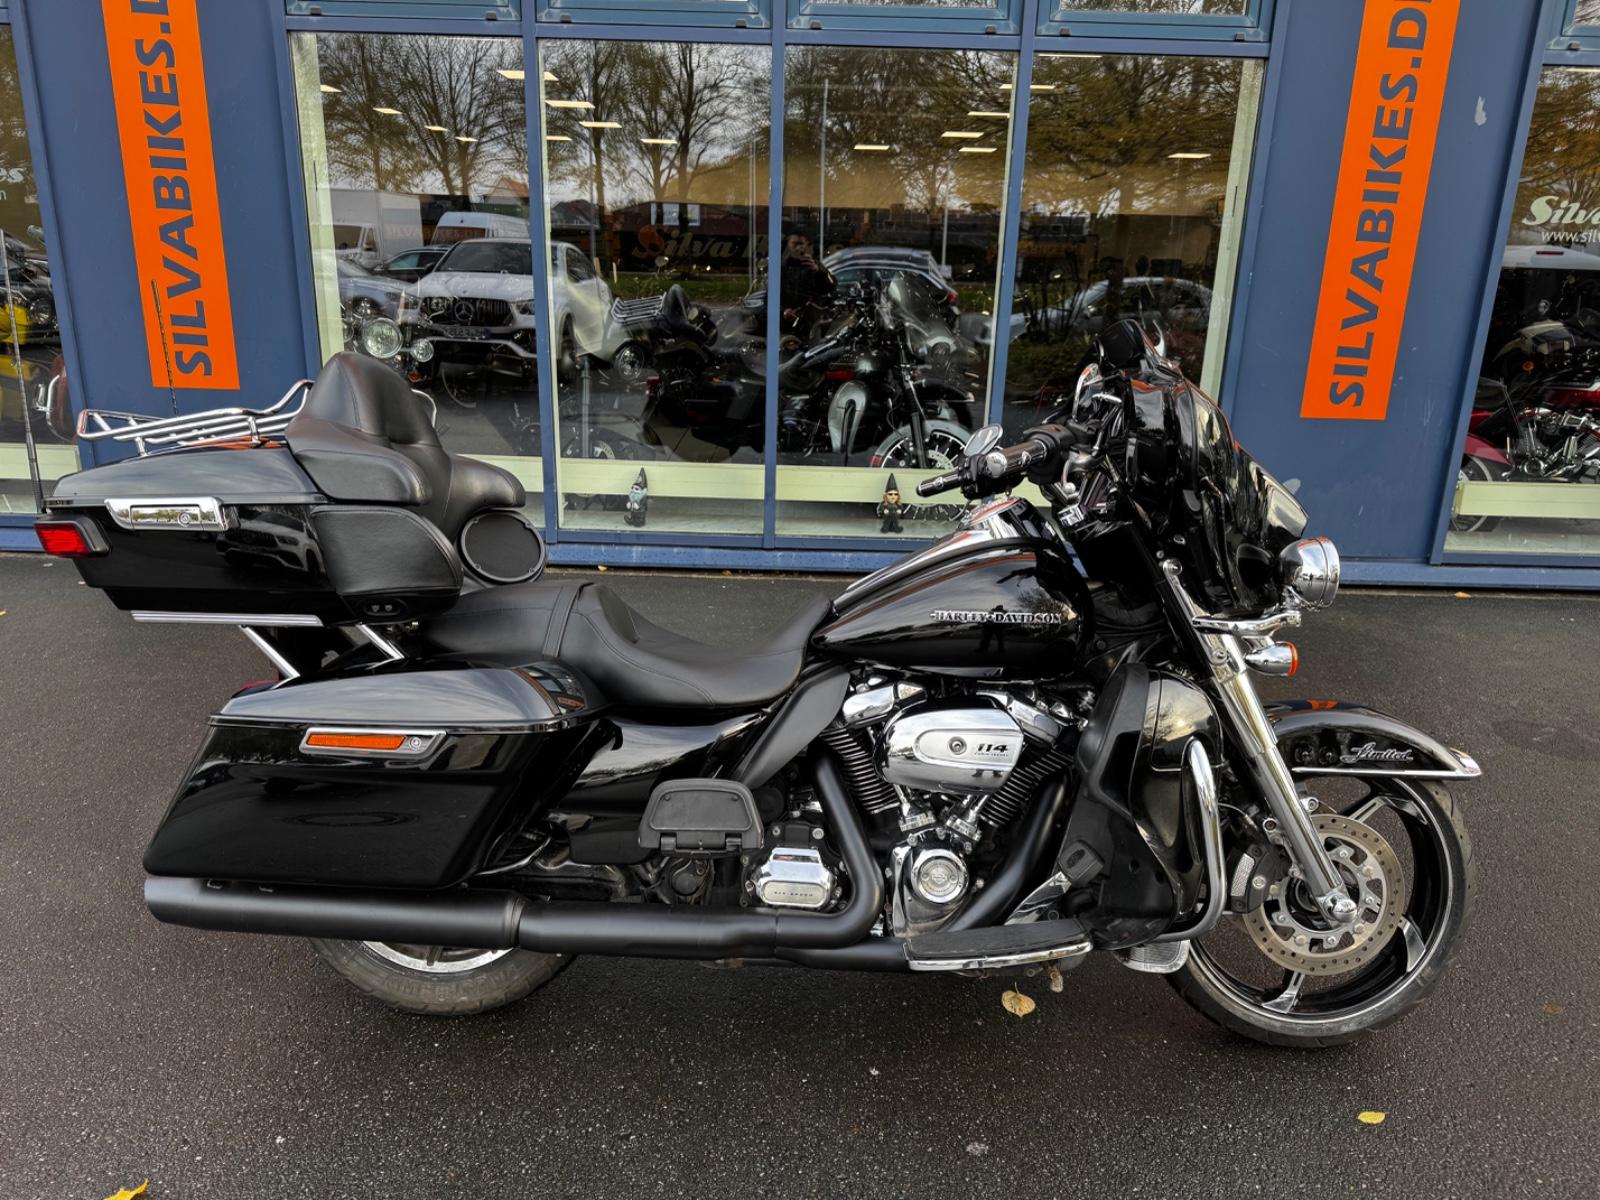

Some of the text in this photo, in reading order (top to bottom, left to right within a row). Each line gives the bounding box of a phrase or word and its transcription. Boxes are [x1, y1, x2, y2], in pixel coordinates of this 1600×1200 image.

[1329, 0, 1431, 406] SILVABIKES.D
[1541, 229, 1600, 243] www.sil
[977, 743, 1009, 752] 114
